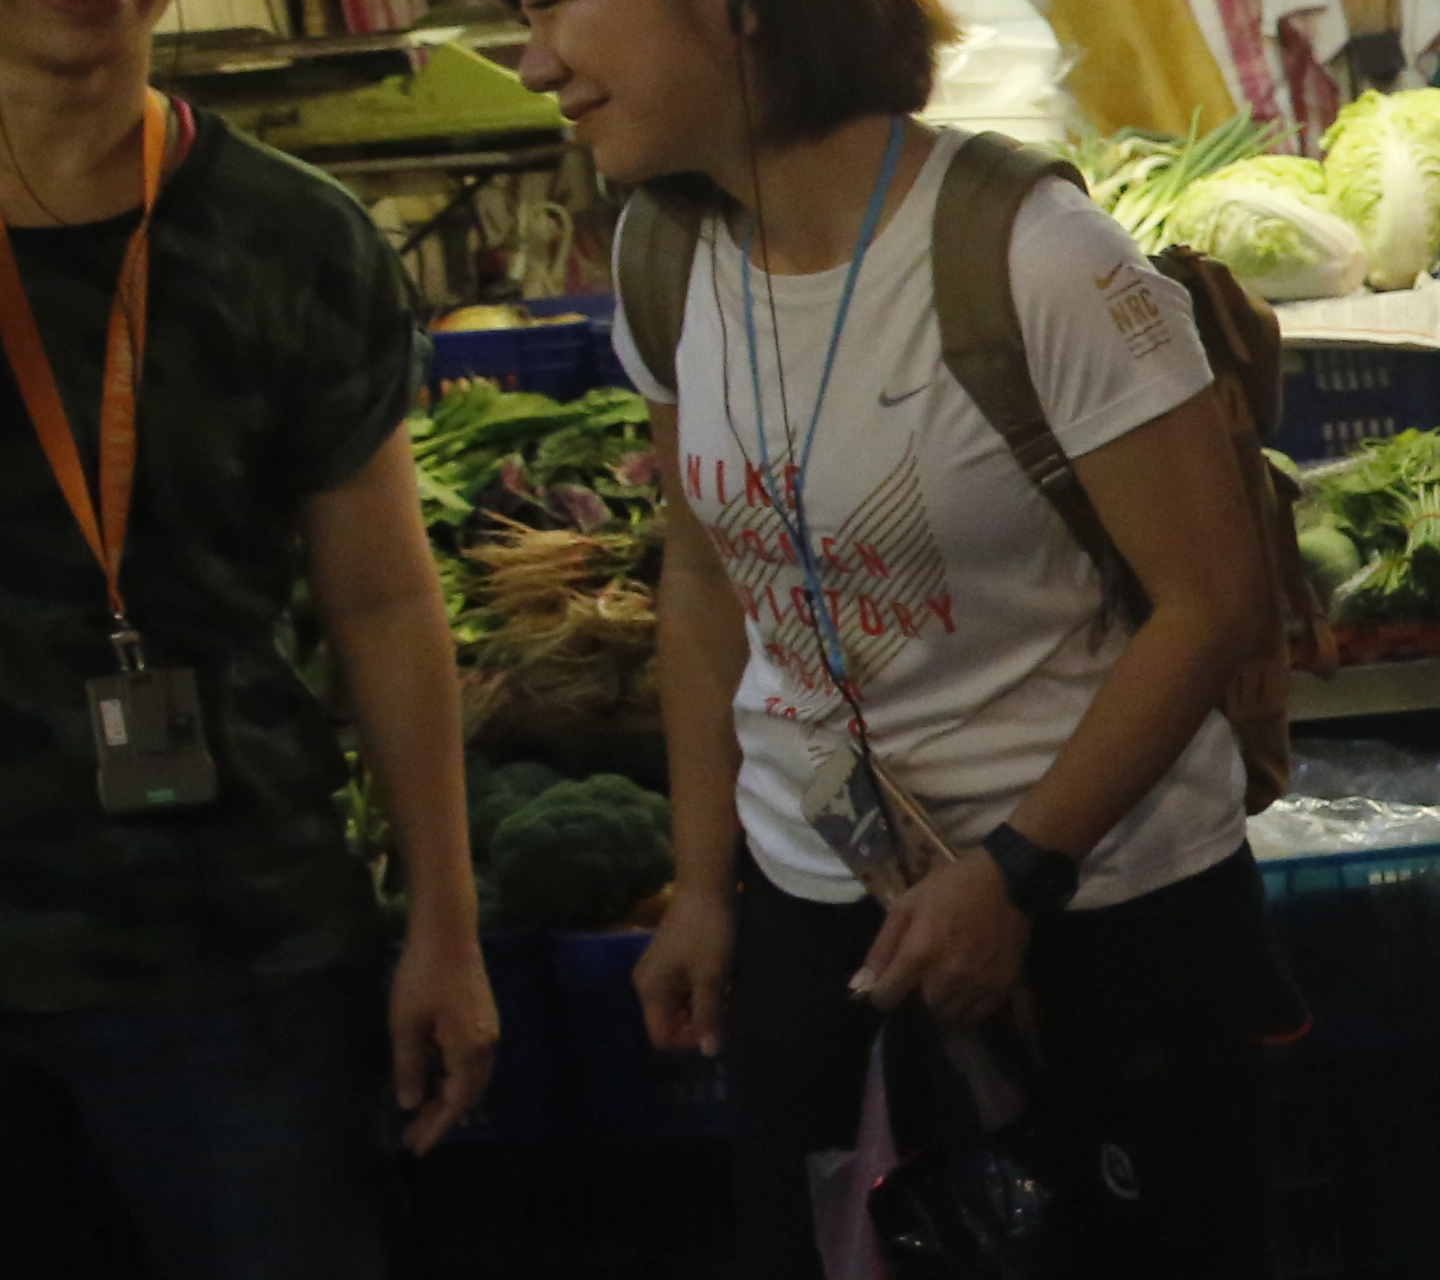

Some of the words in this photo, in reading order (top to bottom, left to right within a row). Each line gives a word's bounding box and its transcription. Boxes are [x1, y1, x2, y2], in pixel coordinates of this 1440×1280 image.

[1106, 287, 1159, 334] NRC
[687, 453, 802, 510] NIKE
[733, 584, 956, 638] VICTORY
